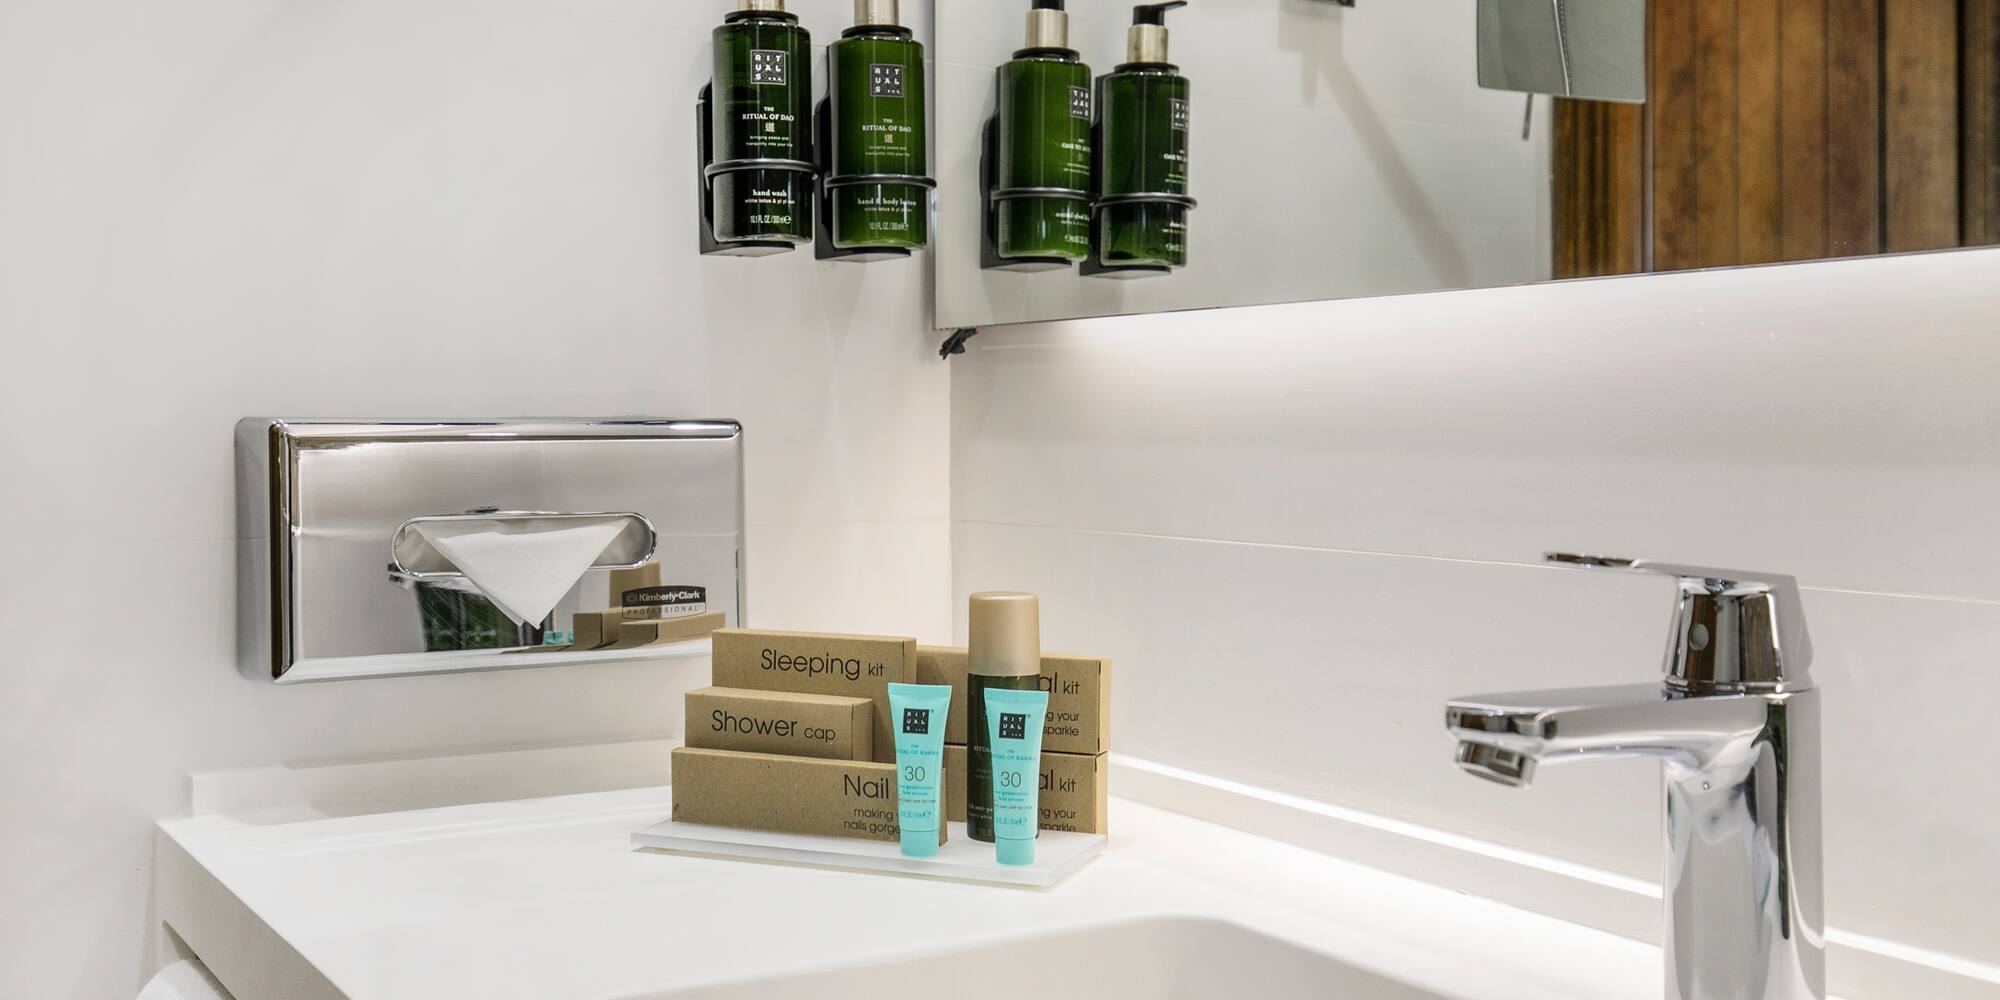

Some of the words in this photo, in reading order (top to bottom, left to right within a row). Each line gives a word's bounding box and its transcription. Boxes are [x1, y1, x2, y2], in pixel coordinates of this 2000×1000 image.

[882, 197, 899, 206] body
[761, 648, 860, 681] Sleeping
[868, 662, 885, 676] kit
[1063, 680, 1080, 695] kit
[1056, 712, 1080, 722] your
[711, 709, 797, 737] Shower
[804, 727, 836, 743] cap
[1043, 726, 1079, 737] sparkle
[904, 765, 925, 782] 30
[1000, 771, 1022, 788] 30
[843, 774, 889, 799] Nail
[1059, 777, 1076, 792] kit
[853, 808, 893, 823] making
[1053, 809, 1076, 820] your
[844, 820, 867, 831] nails
[869, 823, 900, 836] gorge
